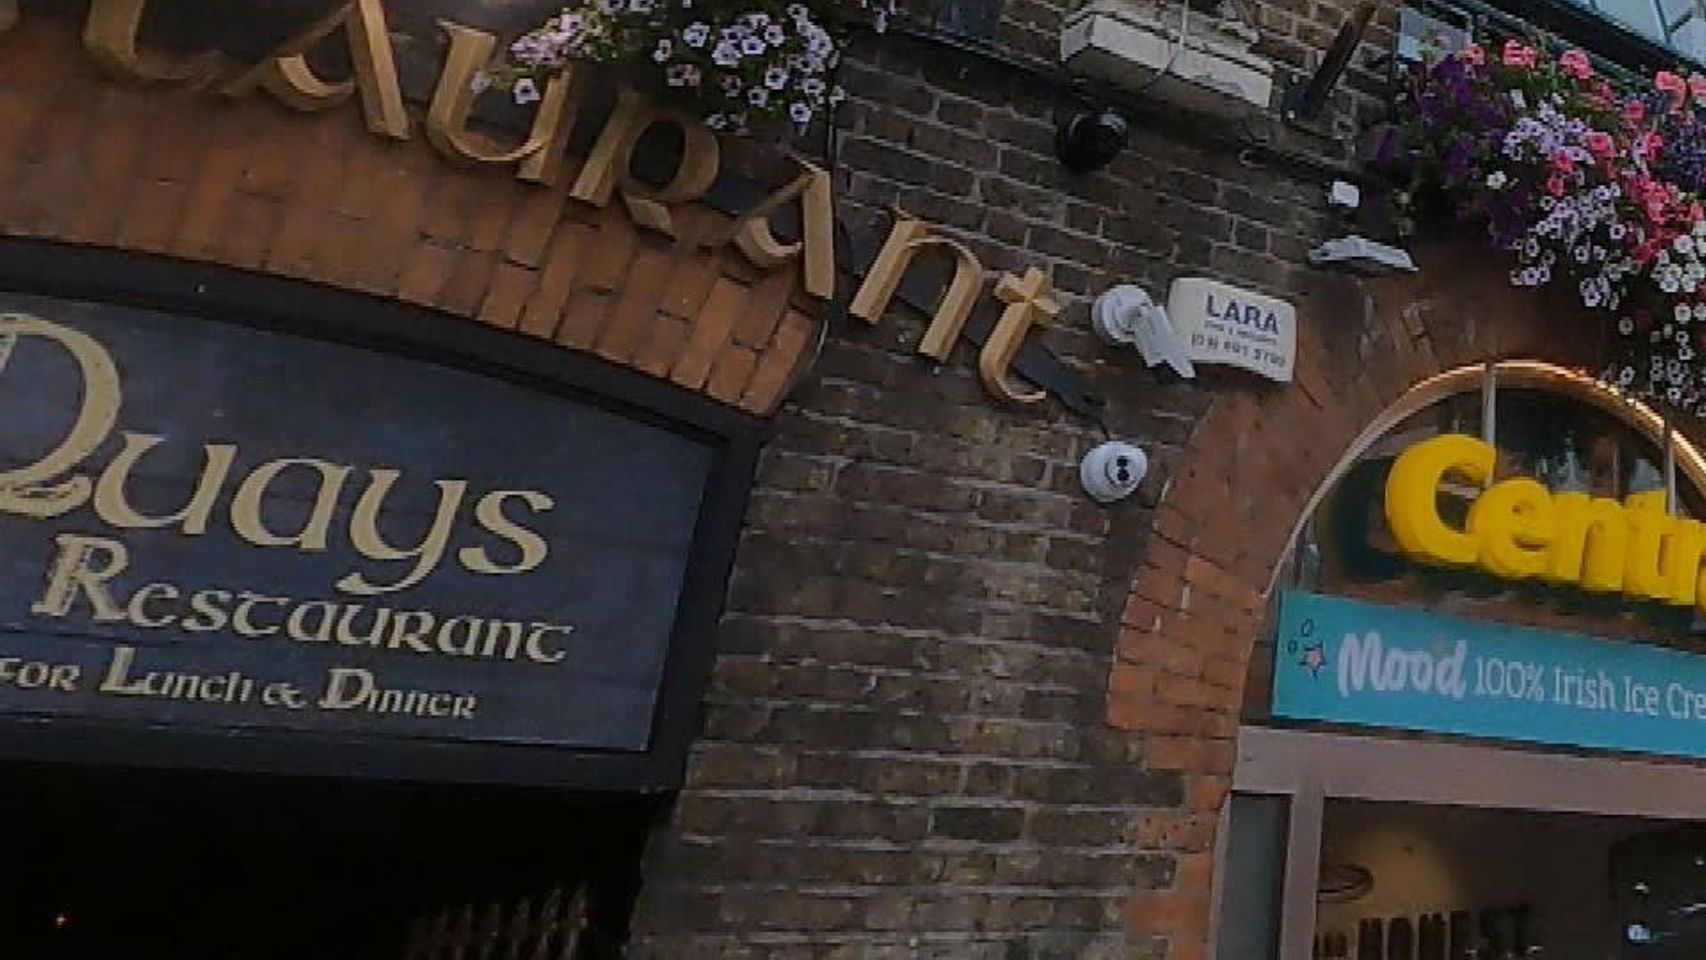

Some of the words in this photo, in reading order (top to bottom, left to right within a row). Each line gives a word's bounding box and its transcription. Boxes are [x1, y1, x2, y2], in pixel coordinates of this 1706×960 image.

[1205, 295, 1279, 335] LARA
[1338, 632, 1468, 699] Mood
[1474, 657, 1546, 703] 100%
[1552, 665, 1617, 712] Irish
[1624, 674, 1661, 717] Ice
